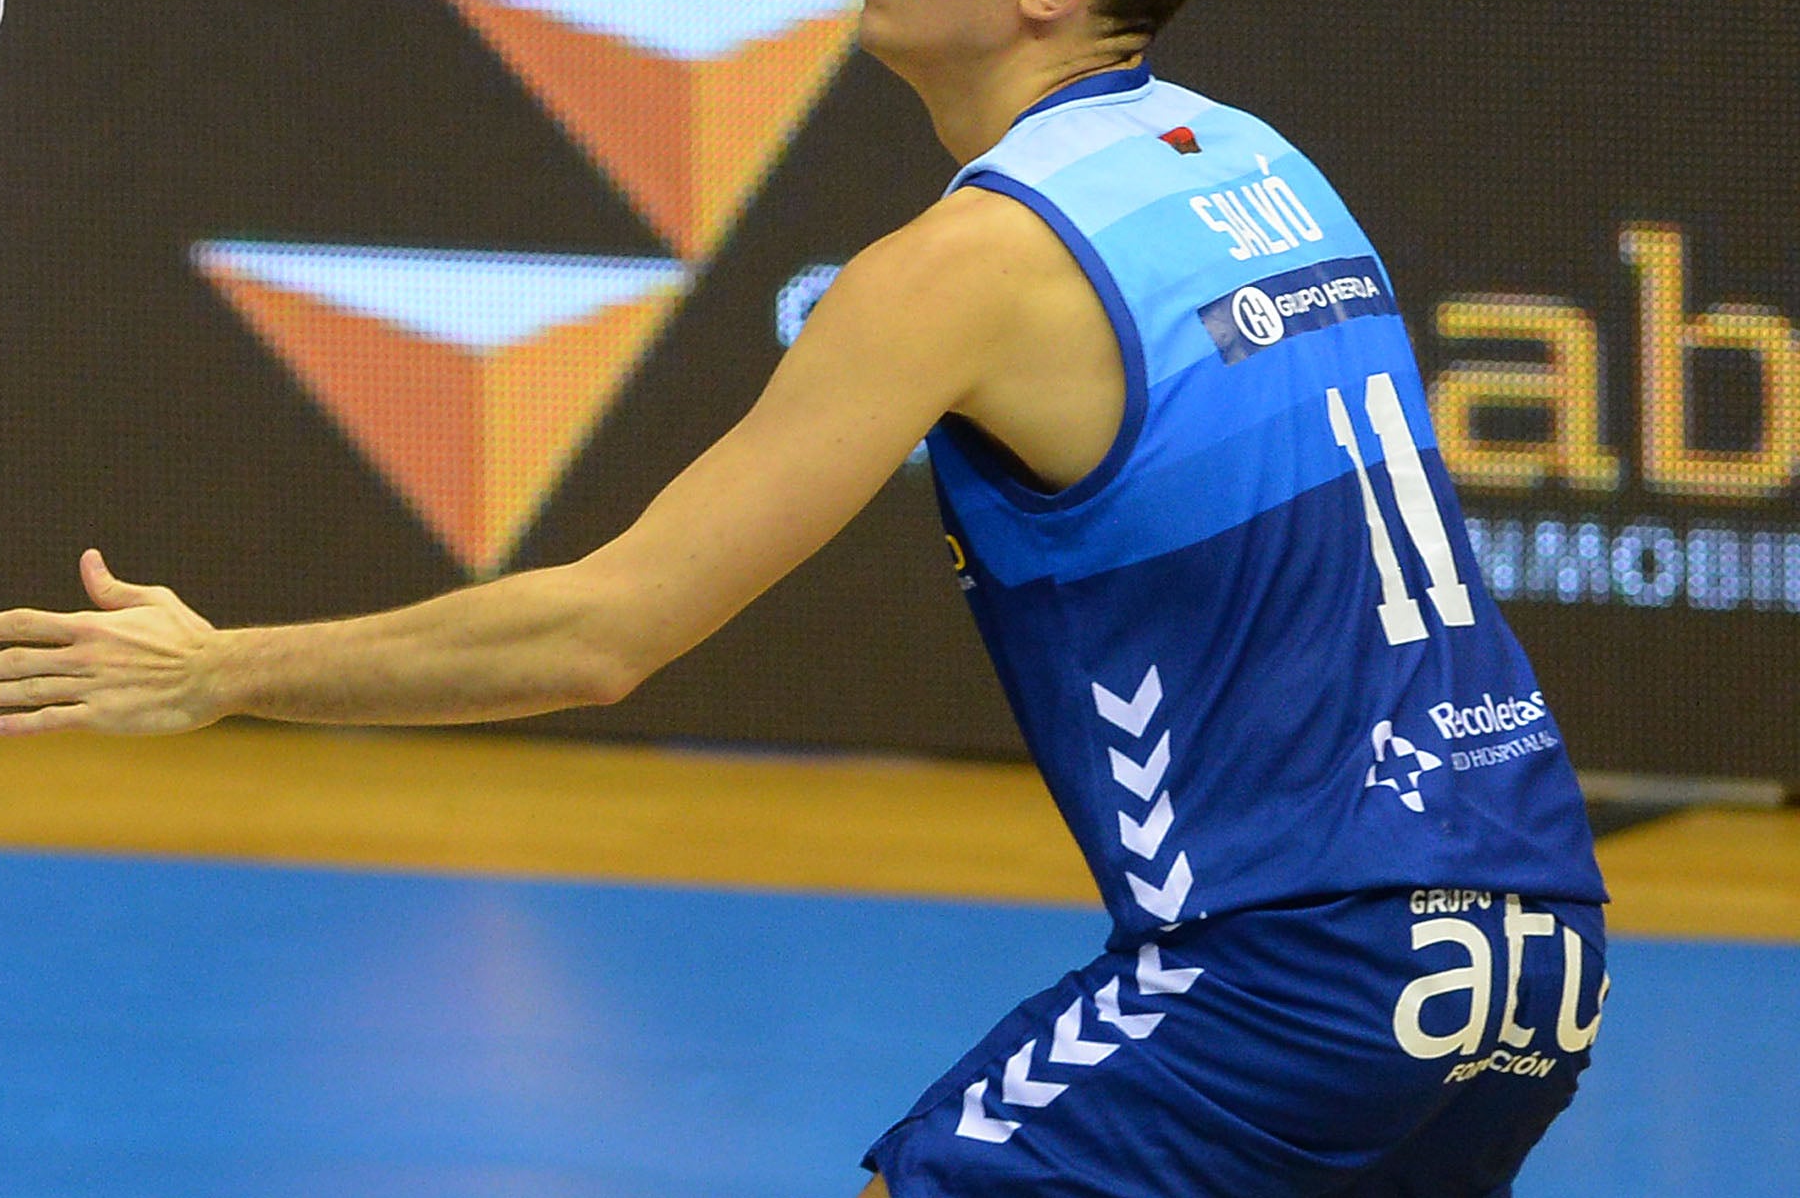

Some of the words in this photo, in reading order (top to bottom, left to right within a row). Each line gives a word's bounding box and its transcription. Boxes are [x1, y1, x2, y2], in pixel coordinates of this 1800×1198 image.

[1189, 153, 1324, 261] SALVÓ
[1326, 372, 1476, 646] 11
[1409, 888, 1492, 915] GRUPO
